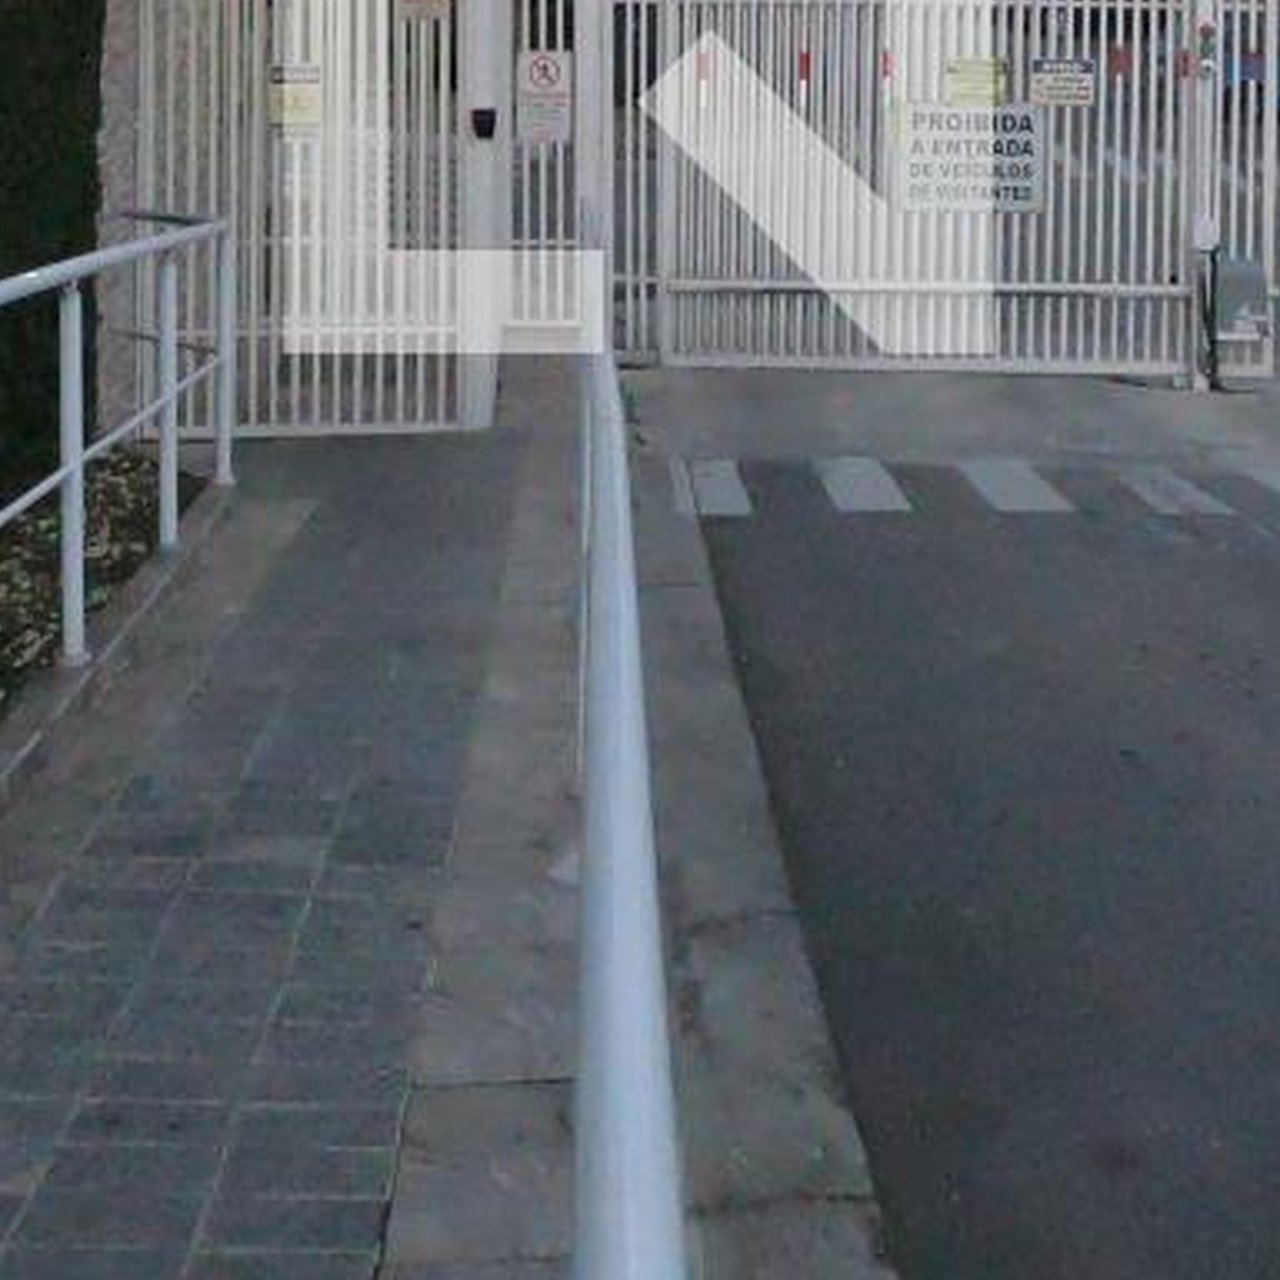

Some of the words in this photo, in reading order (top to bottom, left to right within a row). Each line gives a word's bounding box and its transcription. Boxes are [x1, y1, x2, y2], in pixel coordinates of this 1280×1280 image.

[911, 111, 1035, 134] PROIBIDA
[910, 138, 926, 157] A
[932, 138, 1035, 158] ENTRADA
[909, 163, 933, 178] DE
